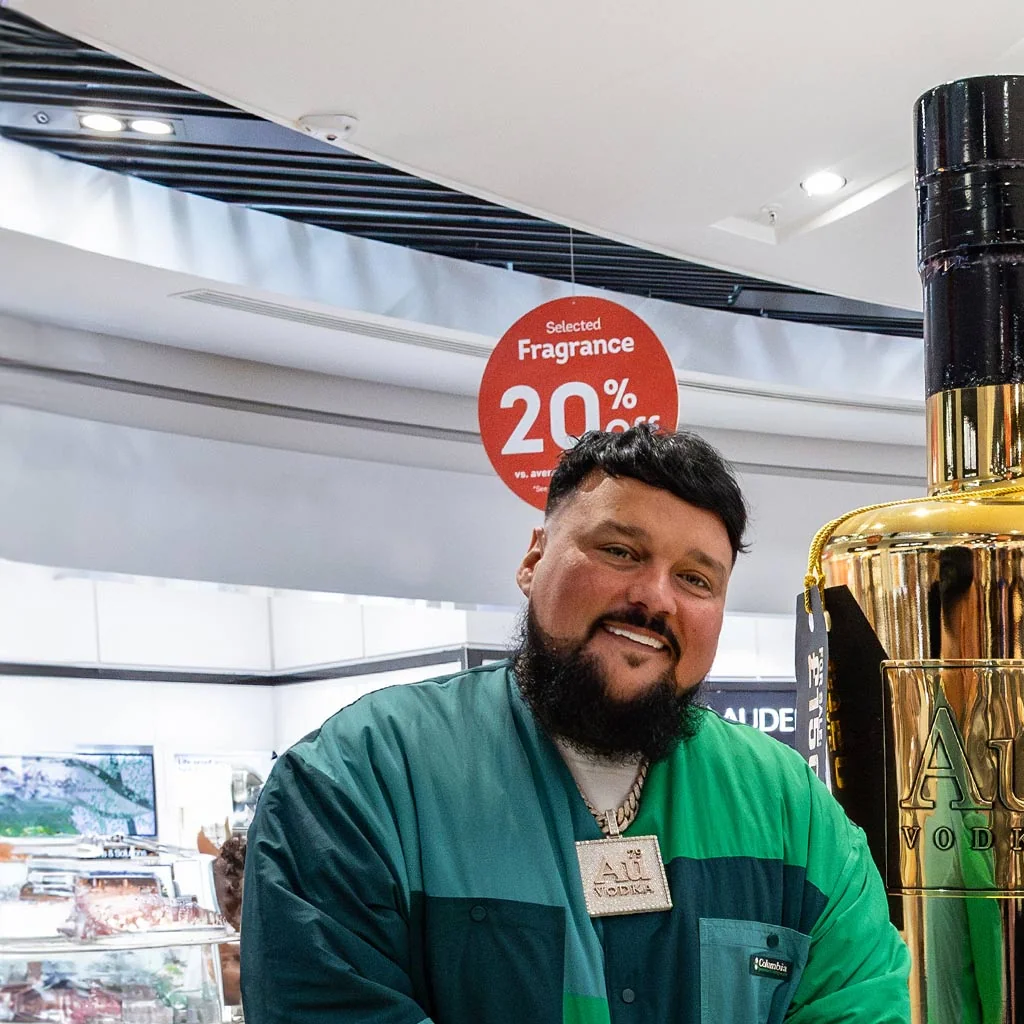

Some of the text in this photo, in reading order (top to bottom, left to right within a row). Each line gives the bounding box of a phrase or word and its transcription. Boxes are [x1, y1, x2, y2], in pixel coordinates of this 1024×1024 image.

[546, 317, 601, 334] Selected
[518, 336, 635, 365] Fragrance
[594, 885, 655, 898] VODKA
[758, 958, 788, 972] Columbia
